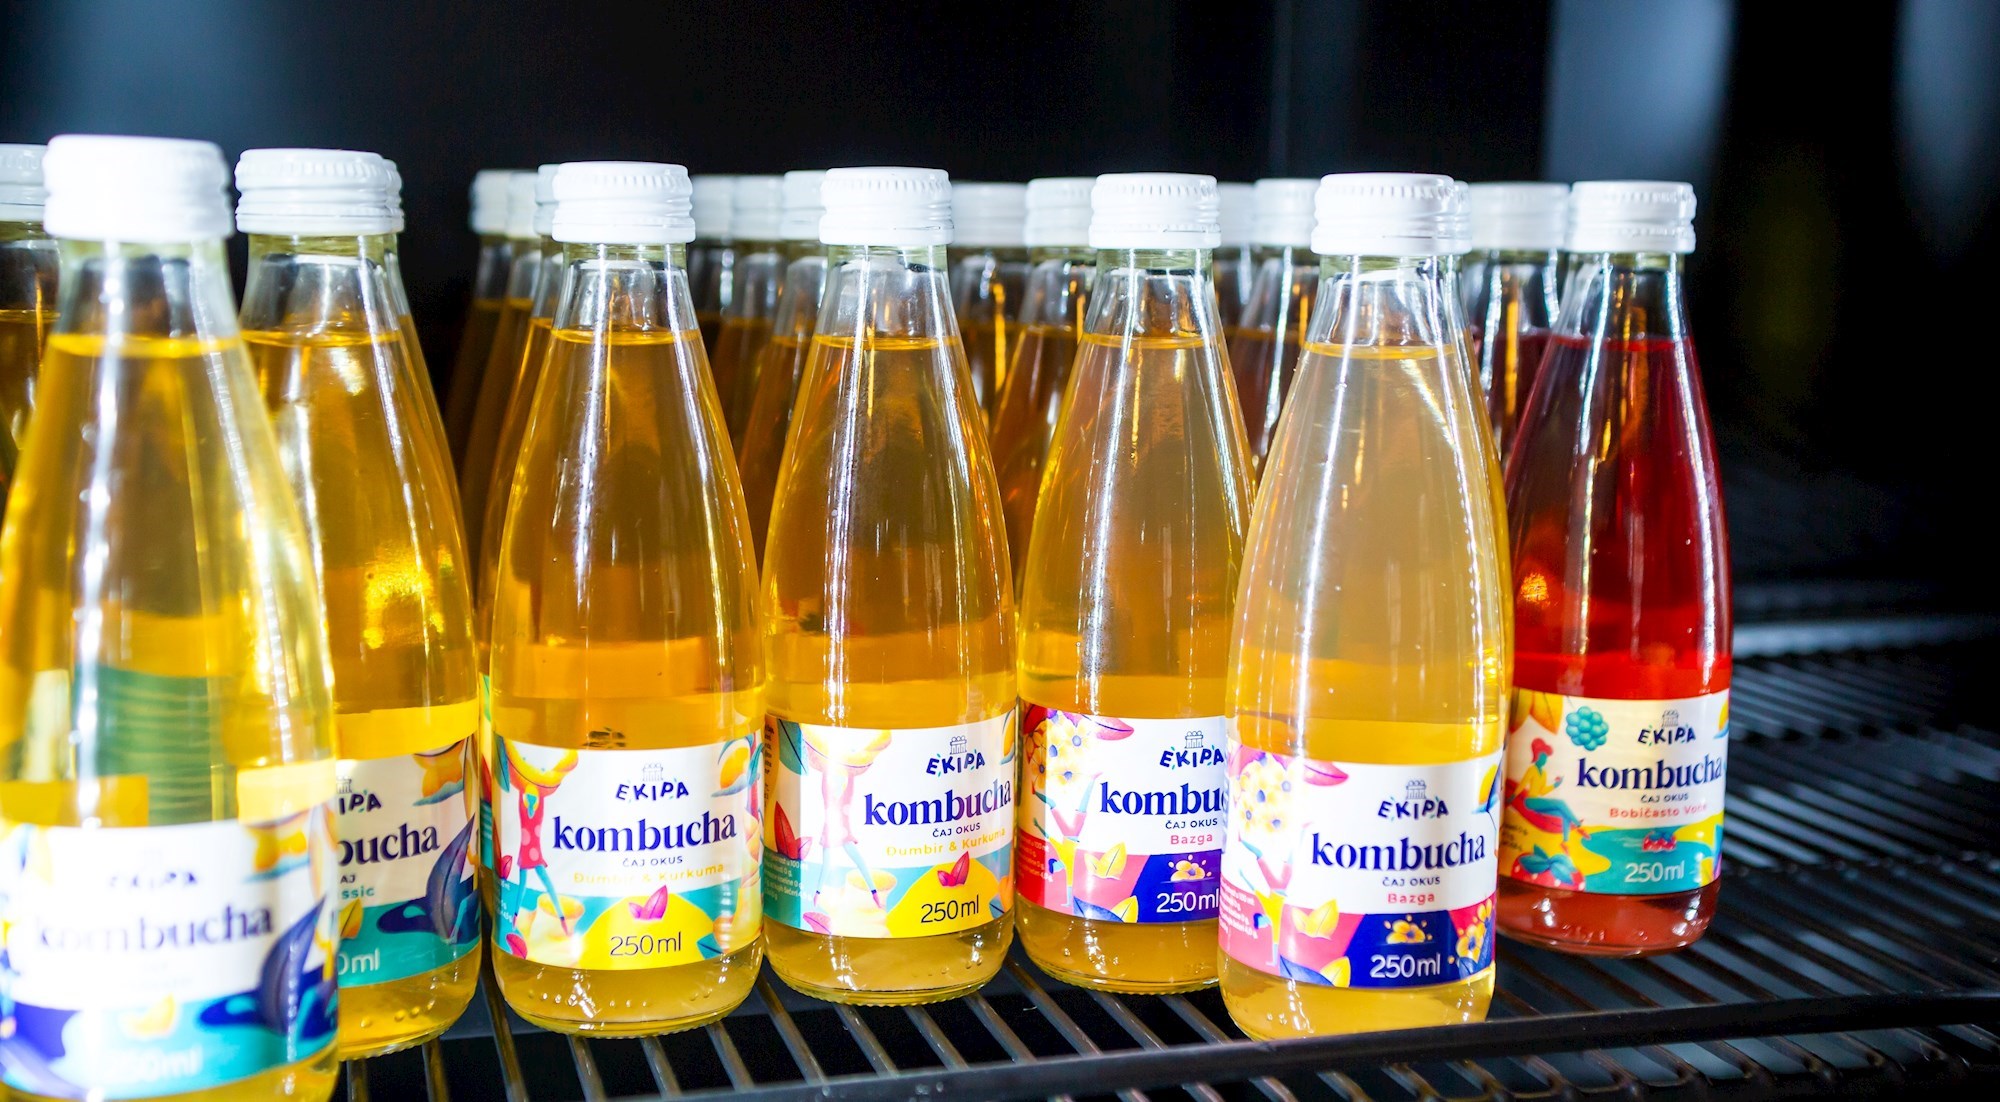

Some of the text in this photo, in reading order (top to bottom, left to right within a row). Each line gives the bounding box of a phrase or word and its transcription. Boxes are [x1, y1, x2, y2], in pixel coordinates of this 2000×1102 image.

[1637, 727, 1696, 745] EKIPA
[926, 751, 985, 775] EKIPA
[1159, 748, 1224, 768] EKIPA
[1576, 754, 1722, 790] kombucha
[615, 781, 689, 801] EKIPA
[1100, 781, 1225, 815] kombu
[338, 793, 382, 815] IPA
[864, 779, 1011, 826] kombucha
[1377, 799, 1449, 820] EKIPA
[552, 810, 737, 851] kombucha
[932, 822, 981, 838] ČAJ OKUS
[1165, 817, 1218, 830] ČAJ OKUS
[337, 822, 440, 866] ucha
[949, 841, 957, 852] &
[962, 828, 1006, 850] Kurkuma
[1171, 833, 1213, 846] Bazga
[622, 855, 683, 867] ČAJ OKUS
[1311, 831, 1485, 871] kombucha
[340, 874, 356, 884] AJ
[660, 863, 724, 881] Kurkuma
[1382, 875, 1440, 887] ČAJ OKUS
[1624, 861, 1686, 883] 250ml
[341, 886, 375, 899] ssic
[1156, 888, 1219, 913] 250ml
[1387, 892, 1435, 906] Bazga
[920, 895, 979, 924] 250ml
[610, 931, 682, 956] 250ml
[1369, 954, 1441, 979] 250ml
